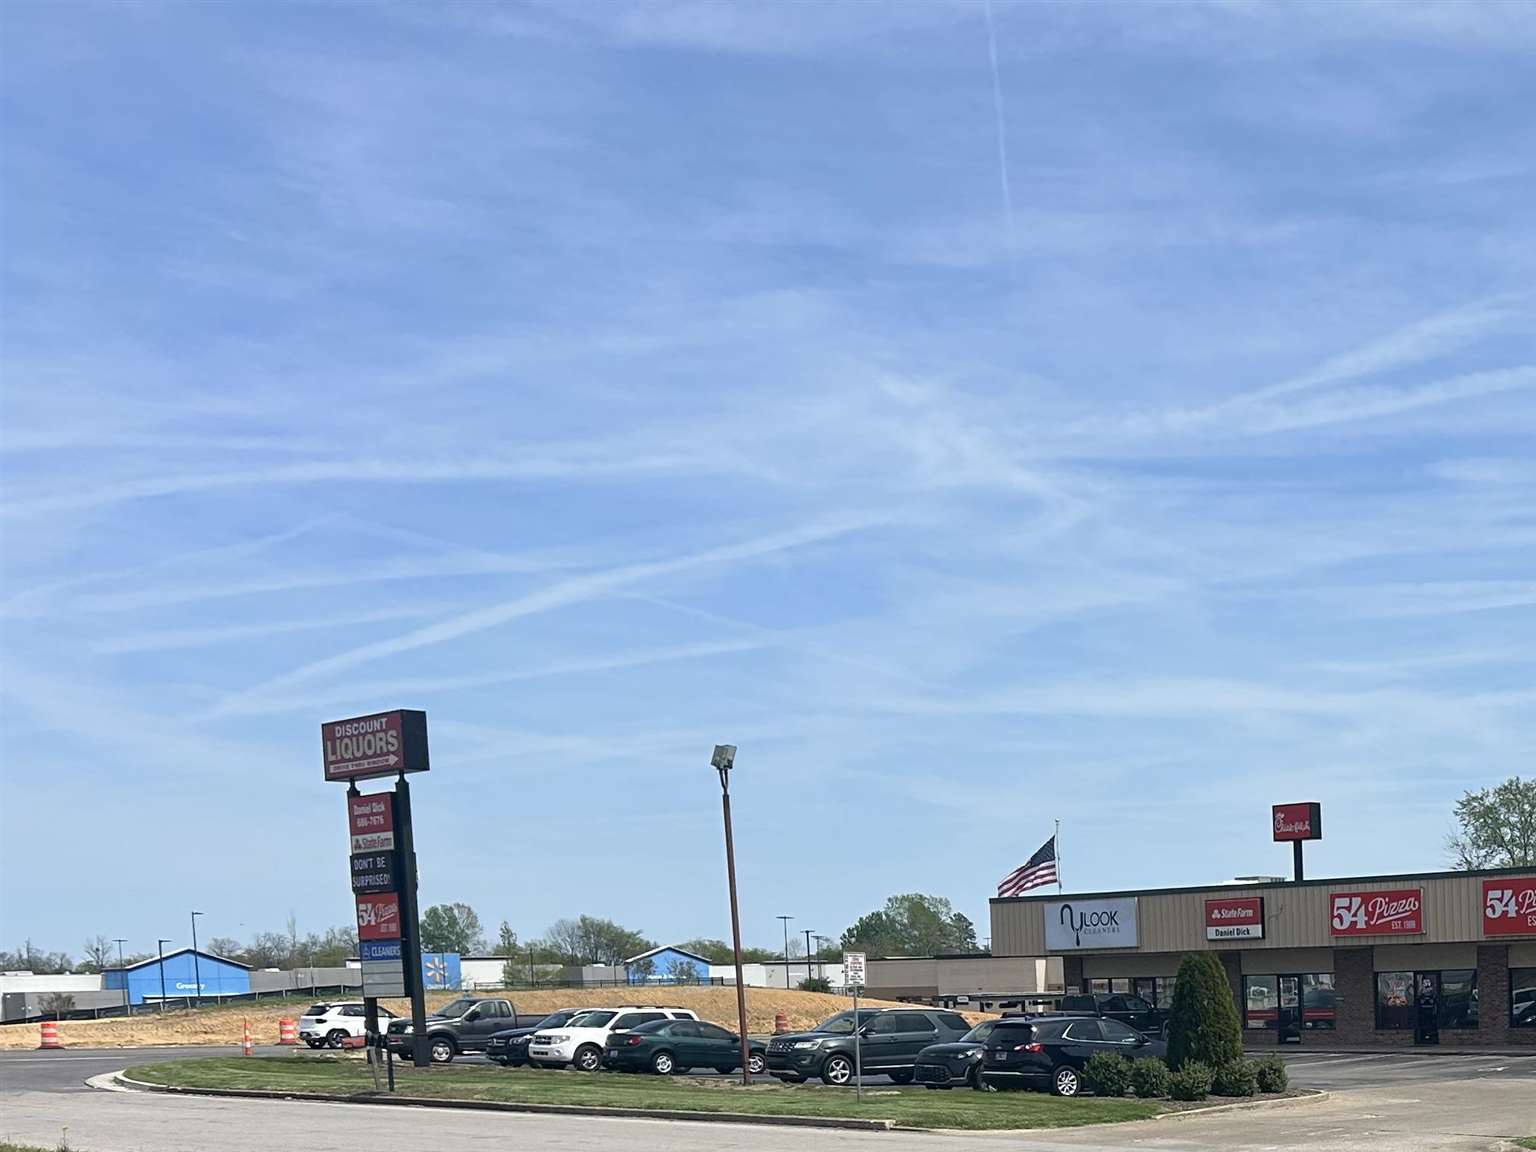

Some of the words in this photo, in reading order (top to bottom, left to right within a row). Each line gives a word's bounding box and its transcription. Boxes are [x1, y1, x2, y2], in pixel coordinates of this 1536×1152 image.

[335, 718, 388, 738] DISCOUNT
[327, 730, 399, 762] LIQUORS
[358, 903, 376, 926] 54
[1332, 896, 1368, 930] 54
[1368, 895, 1419, 925] Pizza
[1485, 889, 1518, 919] 54
[1215, 928, 1235, 937] Daniel
[1236, 927, 1250, 936] Dick
[371, 944, 401, 957] CLEANERS
